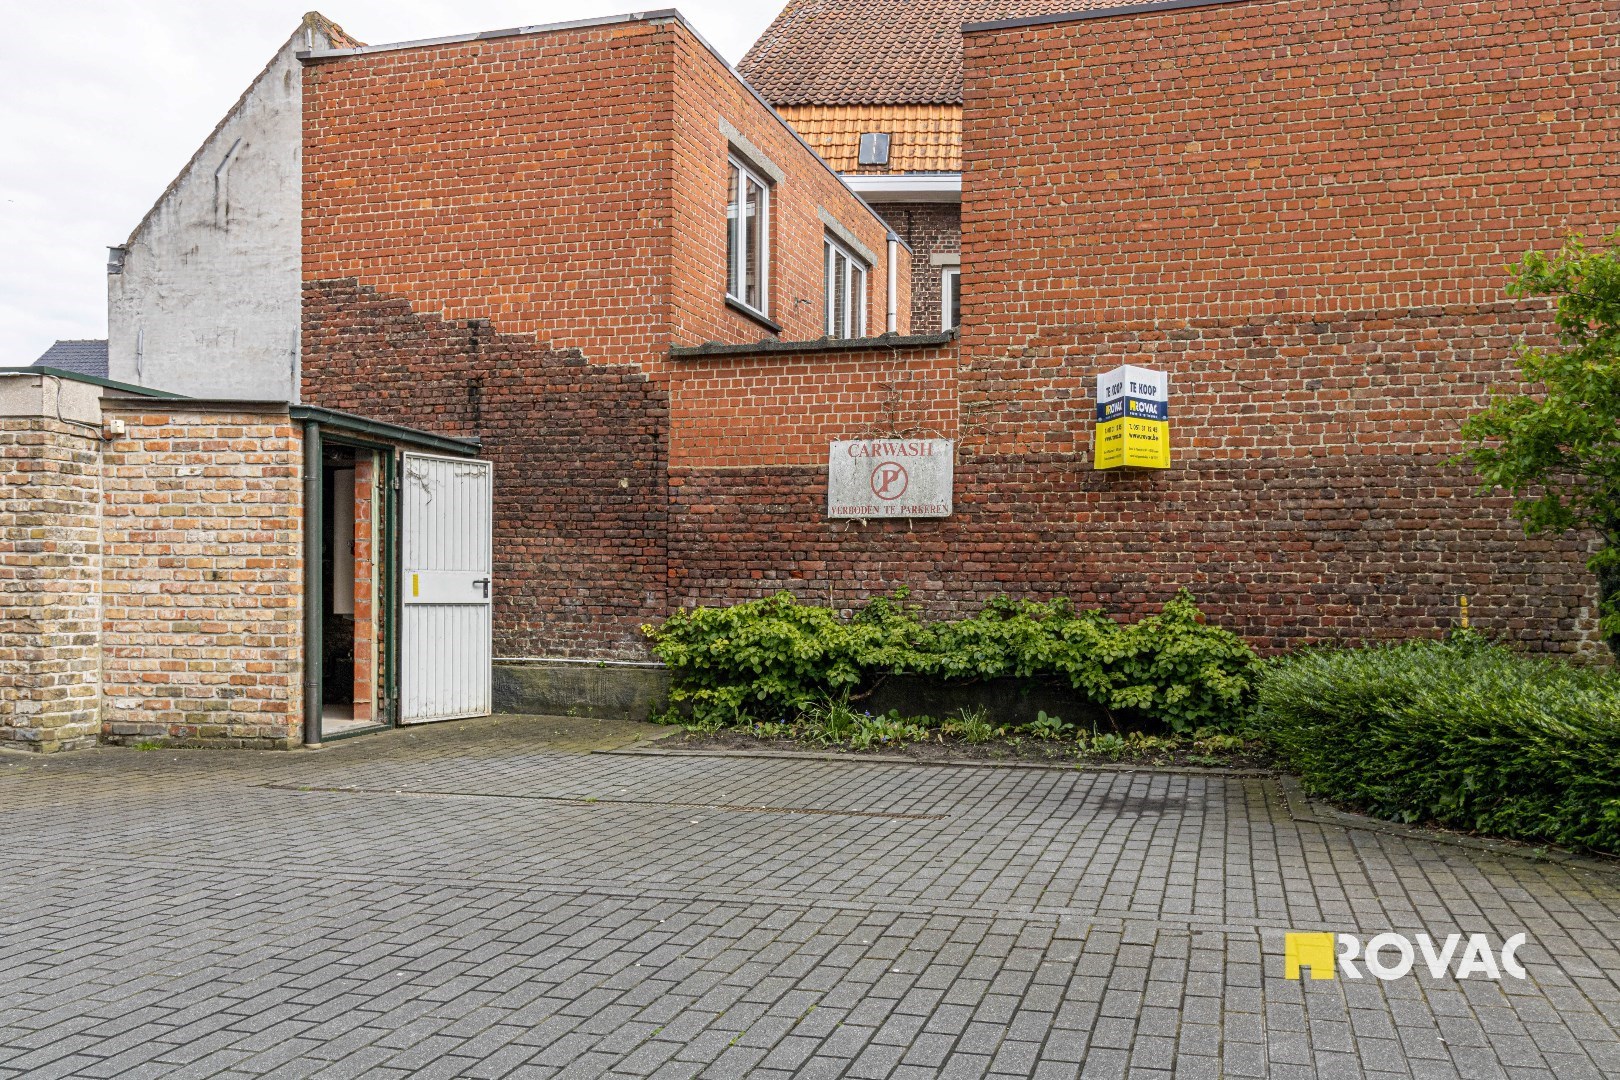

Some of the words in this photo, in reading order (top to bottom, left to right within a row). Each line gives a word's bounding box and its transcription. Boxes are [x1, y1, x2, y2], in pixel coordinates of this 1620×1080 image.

[1130, 382, 1137, 393] TE
[1139, 383, 1157, 396] KOOP
[1135, 401, 1158, 414] ROVAC
[848, 442, 933, 458] CARWASH
[881, 469, 899, 492] P
[831, 505, 880, 515] VERBODEN
[884, 505, 896, 514] TE
[901, 504, 949, 514] PARKEREN
